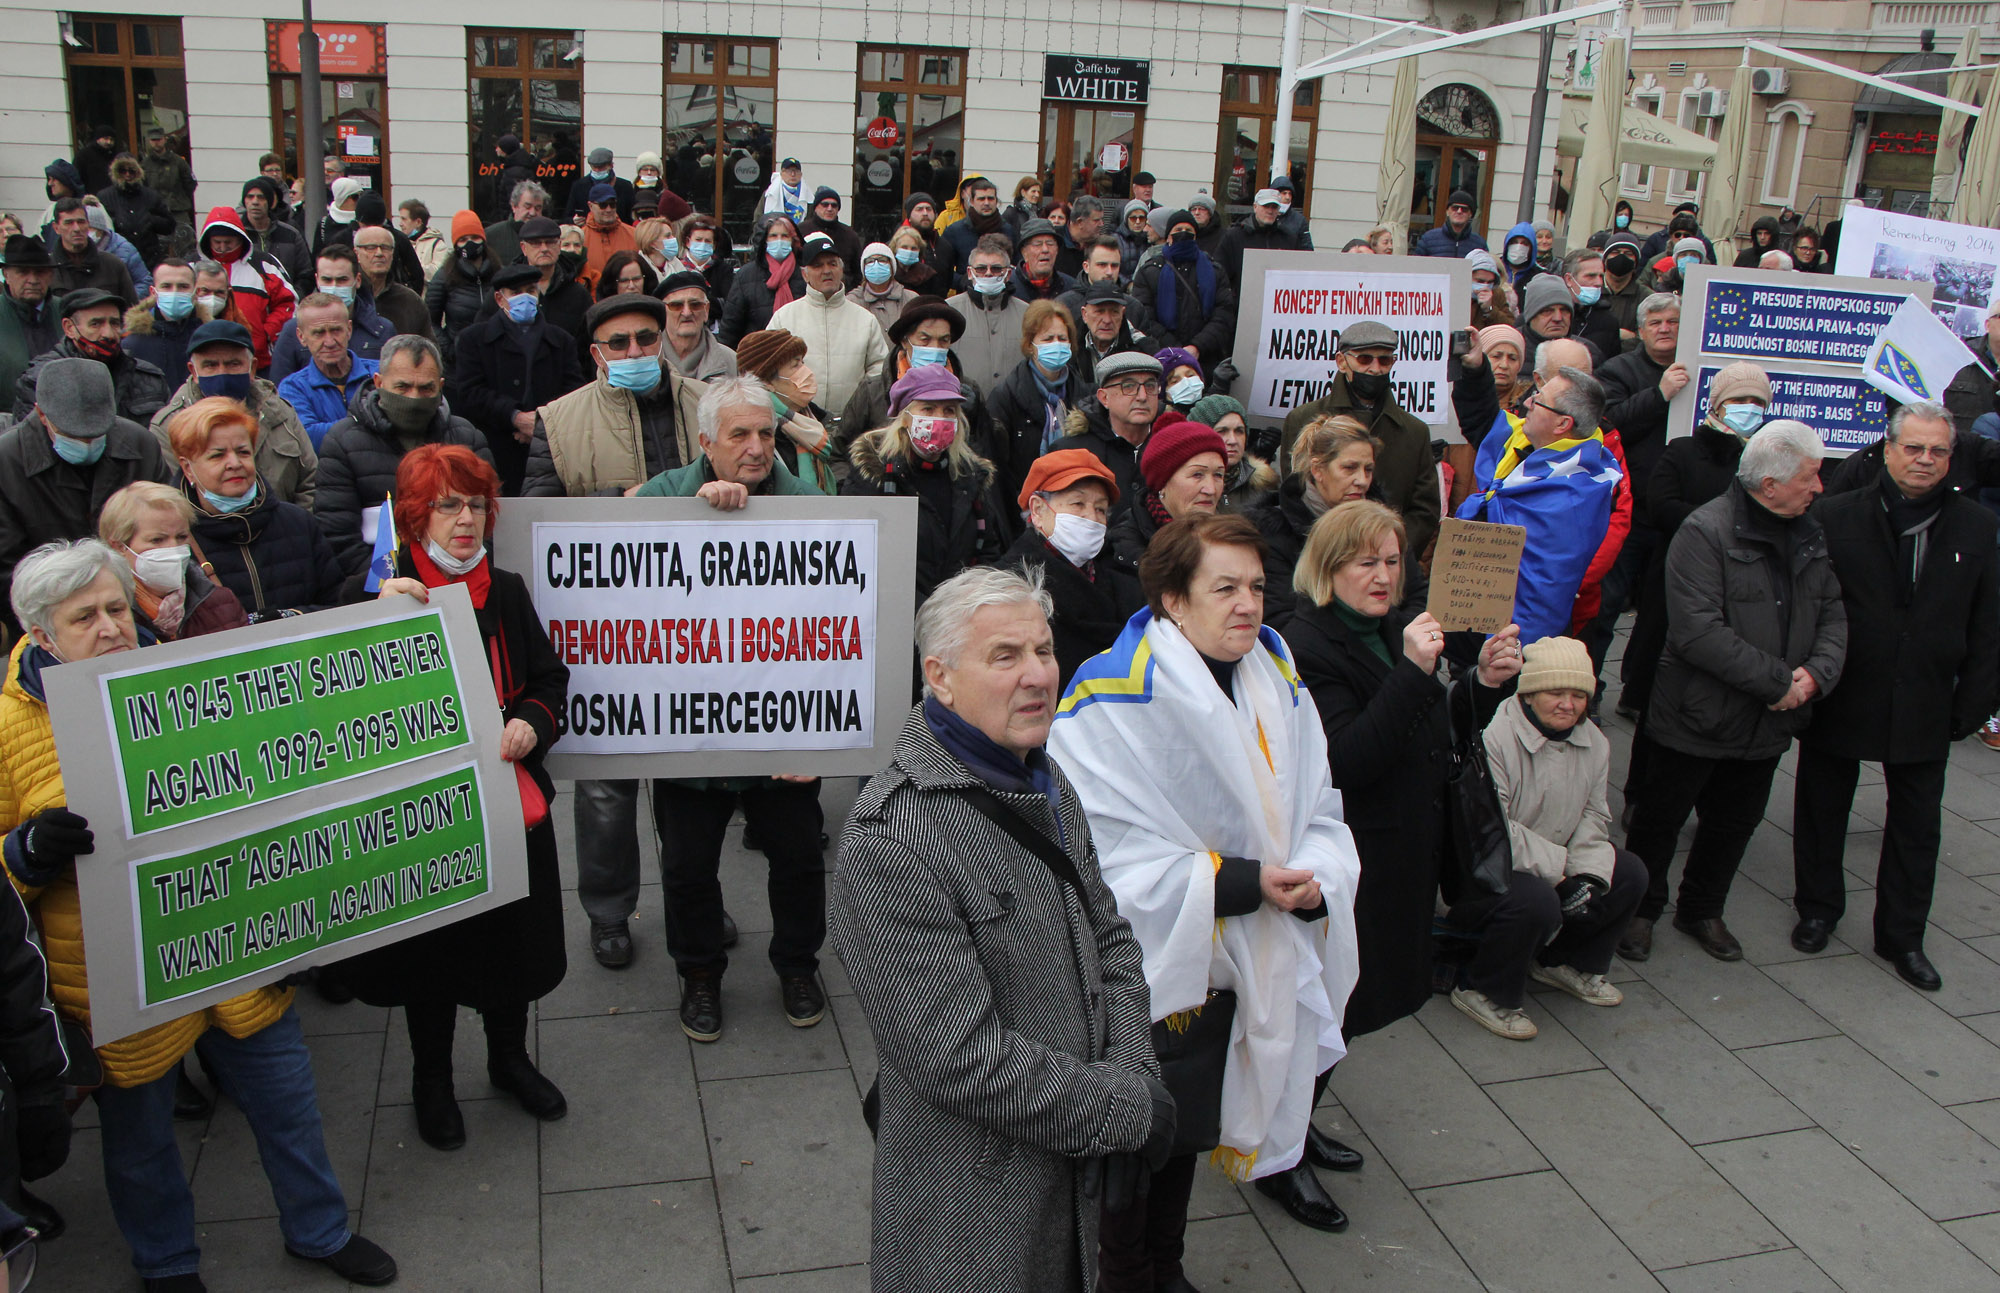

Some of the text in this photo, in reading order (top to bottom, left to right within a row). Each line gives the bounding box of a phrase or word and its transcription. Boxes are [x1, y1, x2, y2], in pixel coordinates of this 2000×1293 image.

[298, 33, 327, 52] h
[1074, 58, 1121, 74] Caffe bar
[1056, 76, 1138, 101] WHITE
[479, 163, 499, 176] bh
[536, 164, 556, 177] bh
[1882, 217, 1994, 254] Remembering 2014
[1273, 282, 1443, 316] KONCEPT ETNIČKIH TERITORIJA
[1721, 303, 1738, 315] EU
[1752, 291, 1804, 309] PRESUDE
[1805, 295, 1872, 314] EVROPSKOG
[1749, 314, 1764, 328] ZA
[1765, 314, 1814, 332] LJUDSKA
[1268, 328, 1443, 361] NAGRAD NOCID
[1707, 331, 1872, 358] ZA BUDUĆNOST BOSNE I HERCEG
[1269, 371, 1436, 412] I ETNIČ ENJE
[1770, 380, 1856, 400] OF THE EUROPEAN
[1782, 402, 1817, 419] RIGHTS
[1824, 406, 1854, 421] BASIS
[1866, 401, 1882, 413] EU
[1830, 428, 1883, 445] HERZEGOVIN
[547, 540, 866, 597] CJELOVITA, GRAĐANSKA,
[549, 615, 863, 664] DEMOKRATSKA I BOSANSKA
[125, 632, 447, 741] IN 1945 THEY SAID NEVER
[654, 693, 661, 735] I
[669, 688, 862, 735] HERCEGOVINA
[145, 695, 460, 816] AGAIN, 1992-1995 WAS
[153, 854, 233, 916] THAT
[355, 806, 398, 854] WE
[401, 781, 473, 840] DON'T
[158, 843, 483, 982] WANT AGAIN, AGAIN IN 2022!
